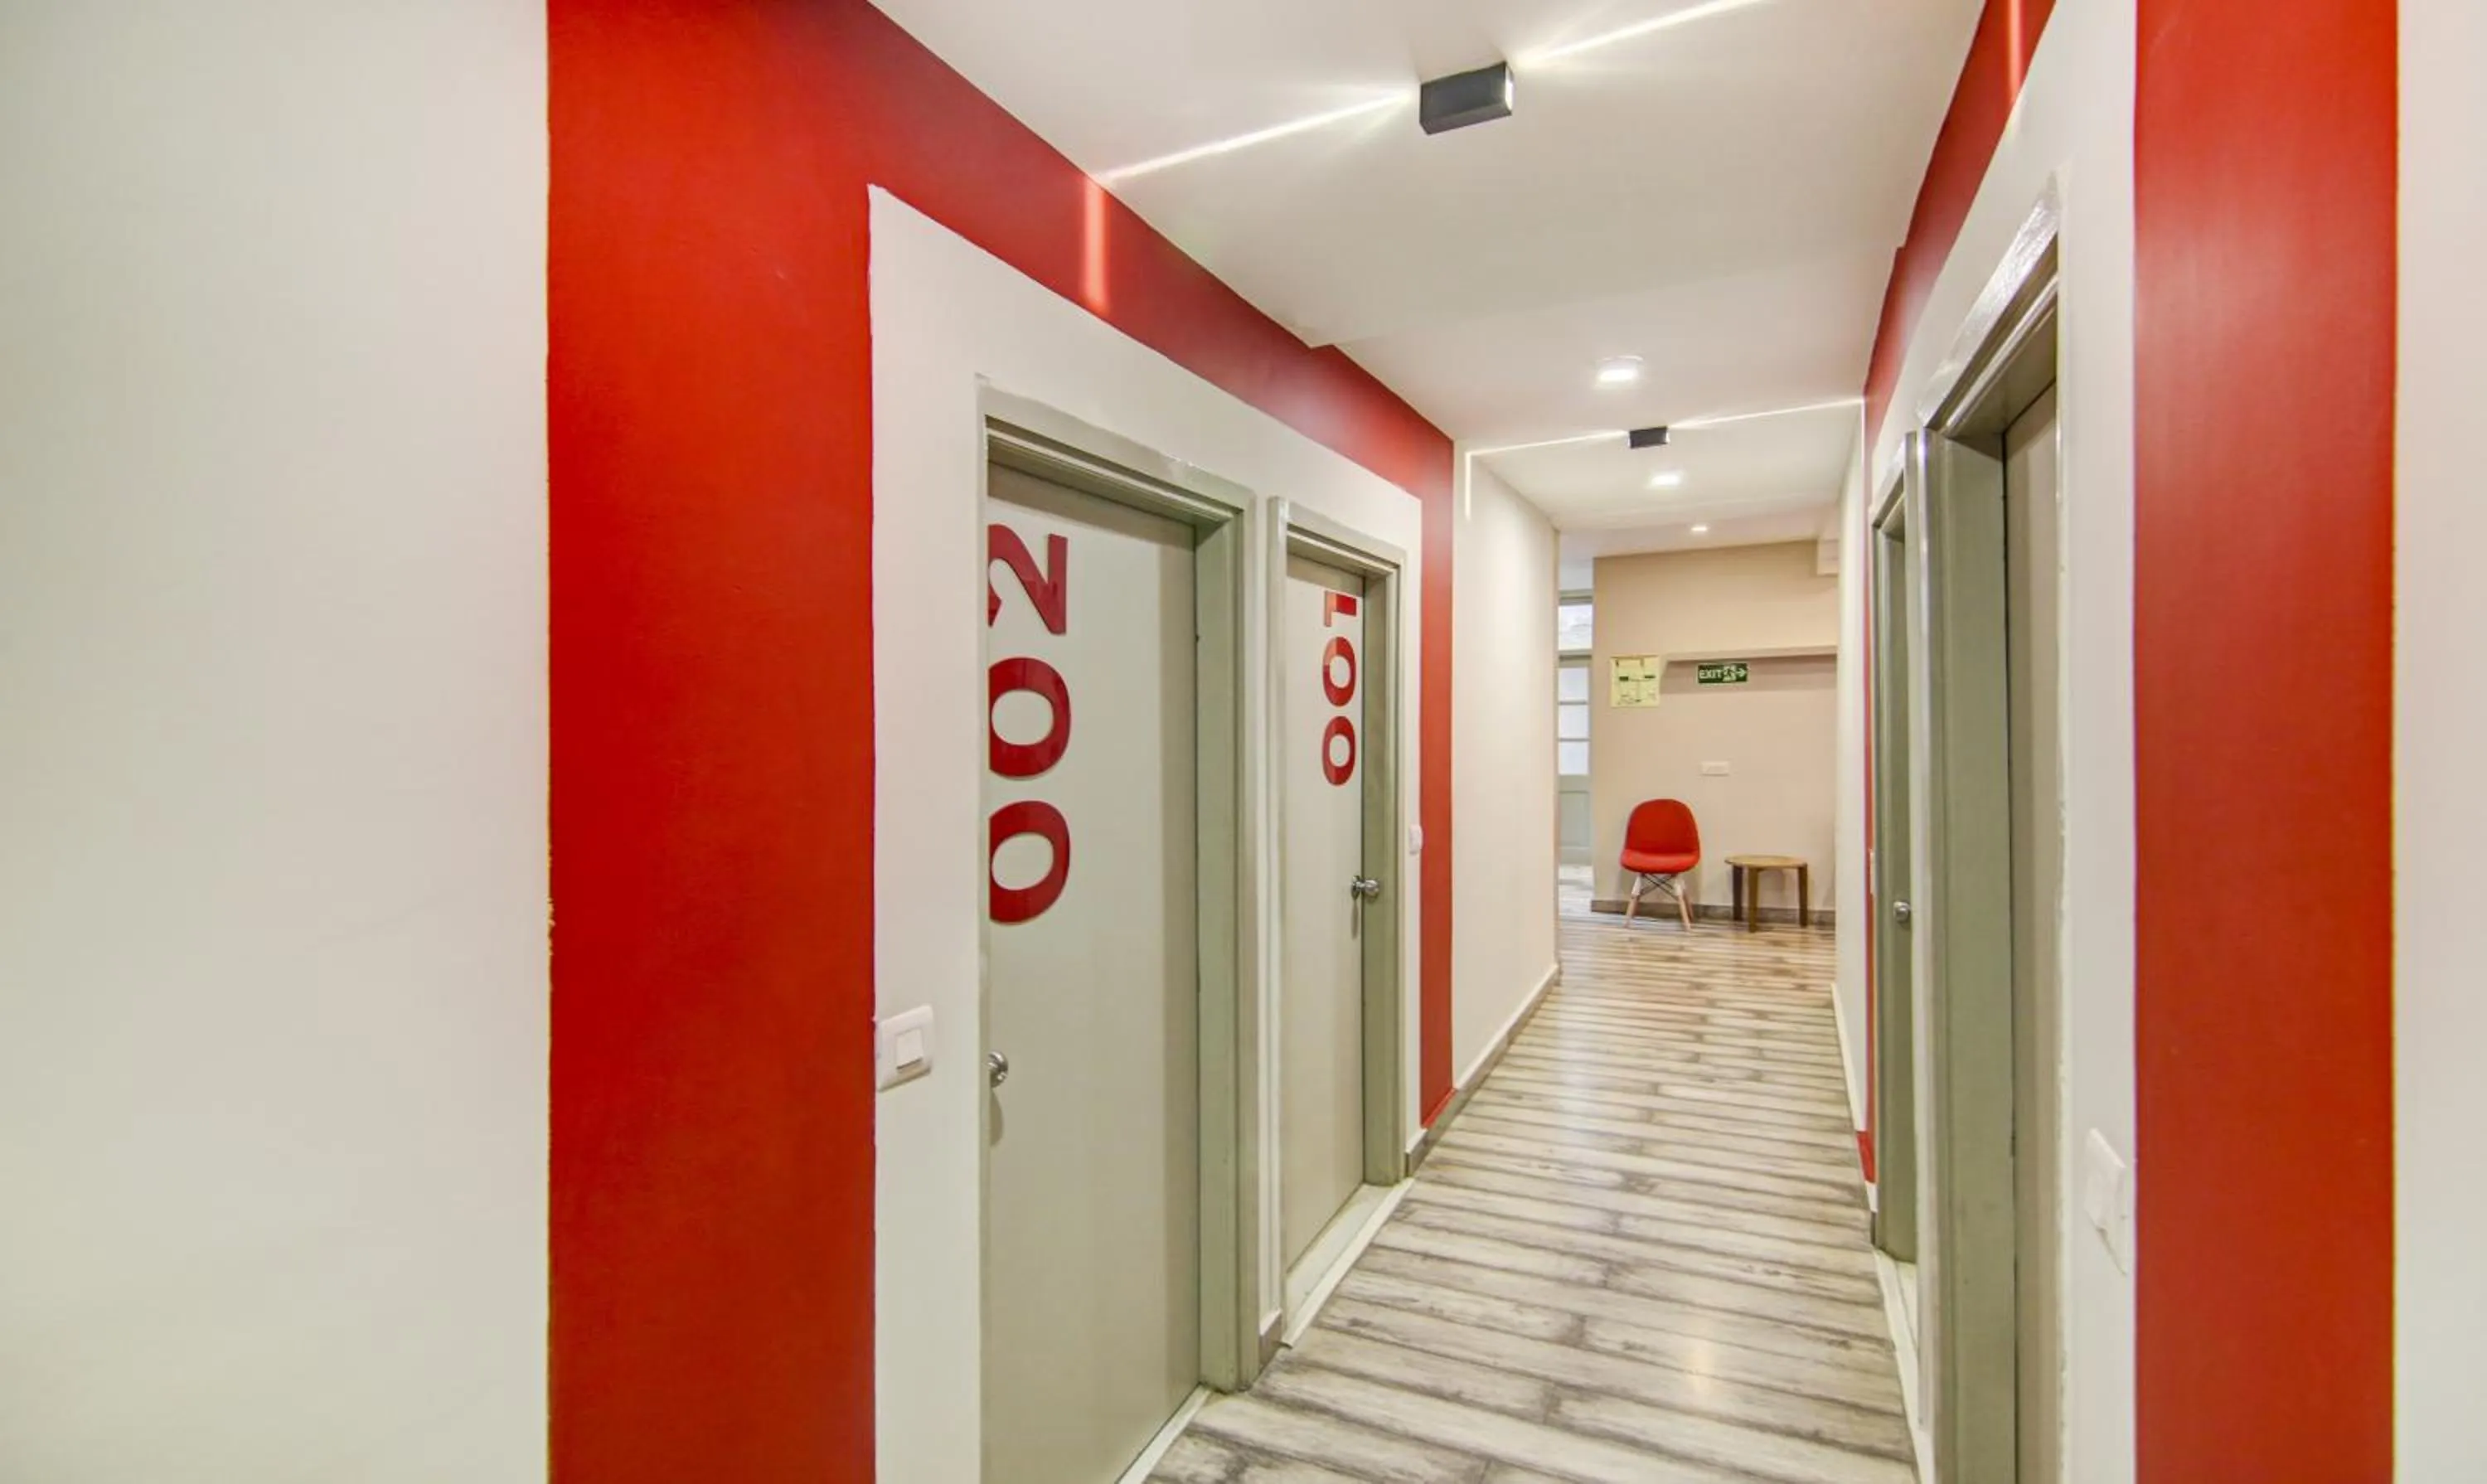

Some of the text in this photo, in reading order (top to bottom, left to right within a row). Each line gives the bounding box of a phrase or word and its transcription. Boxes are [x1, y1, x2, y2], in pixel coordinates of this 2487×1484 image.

[987, 524, 1070, 925] 002
[1322, 590, 1357, 786] 001
[1699, 669, 1722, 679] EXIT
